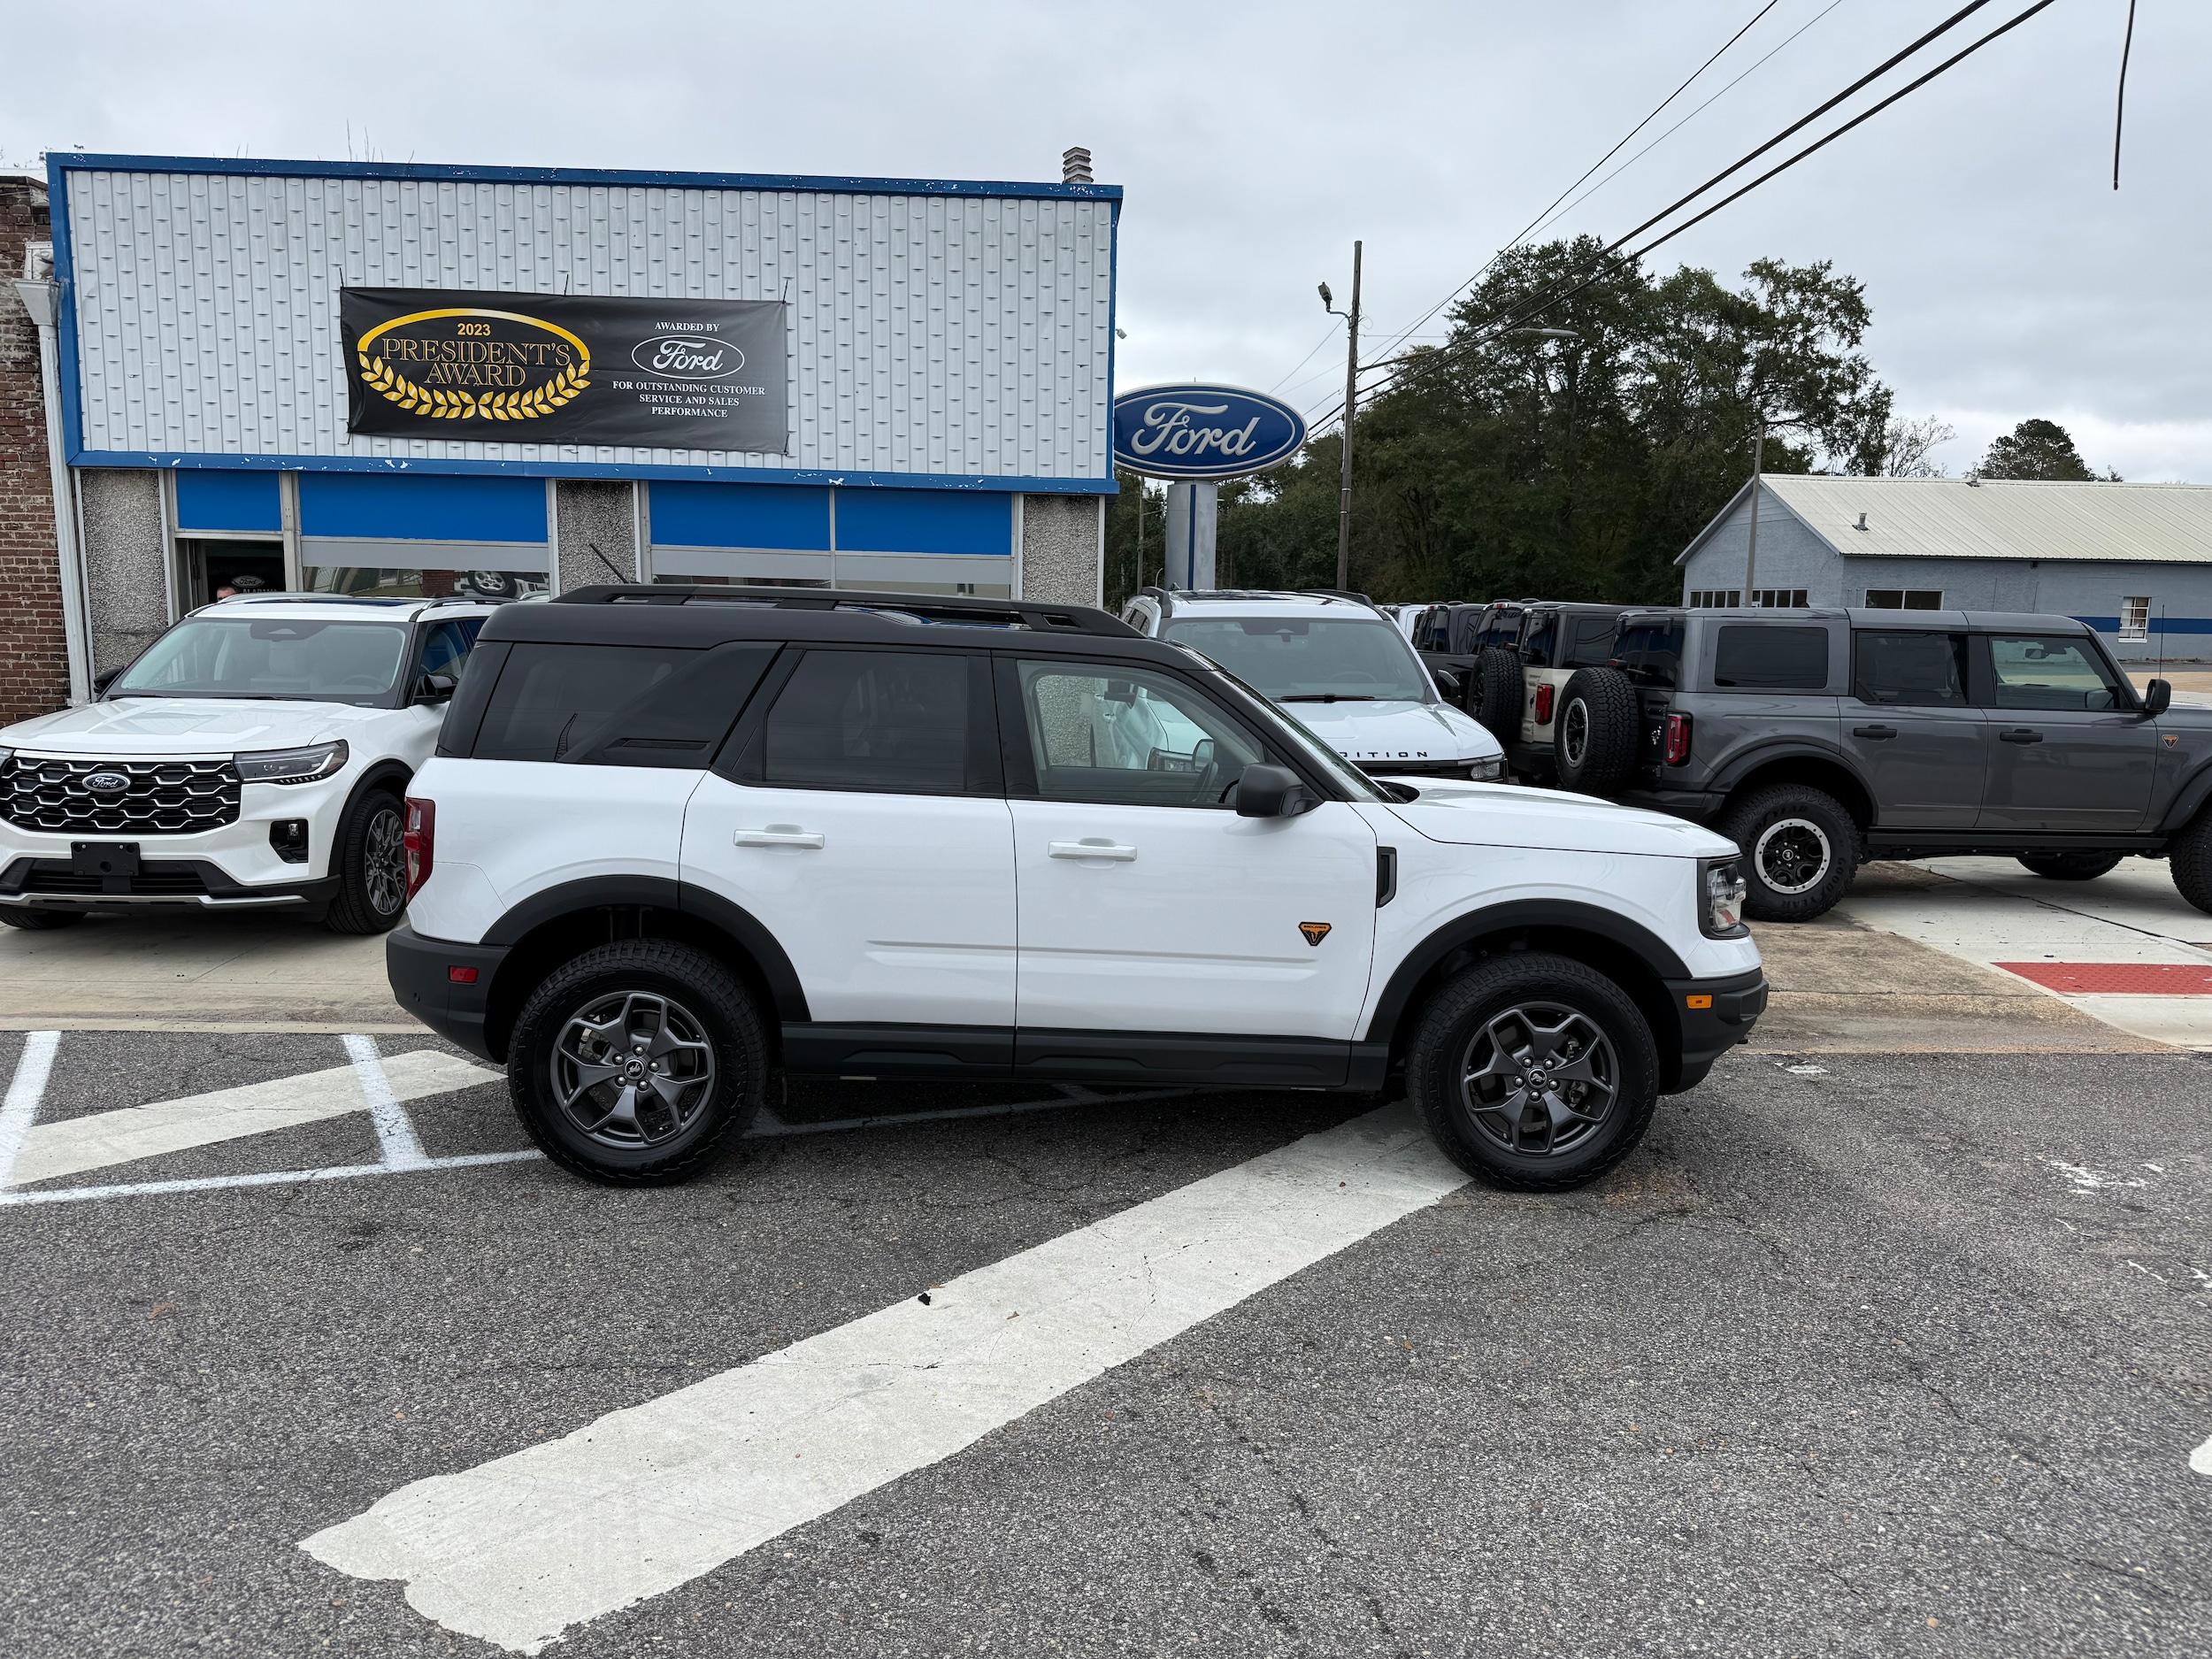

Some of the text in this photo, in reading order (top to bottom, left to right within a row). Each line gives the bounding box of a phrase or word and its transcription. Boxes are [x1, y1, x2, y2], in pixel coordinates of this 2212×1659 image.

[457, 323, 491, 336] 2023
[655, 321, 720, 332] AWARDED BY
[381, 338, 571, 366] PRESIDENT'S
[652, 340, 724, 372] Ford
[424, 363, 527, 387] AWARD
[612, 380, 765, 396] FOR OUTSTANDING CUSTOMER
[639, 394, 740, 406] SERVICE AND SALES
[651, 406, 728, 418] PERFORMANCE
[1131, 402, 1262, 457] Ford
[92, 776, 119, 787] Ford
